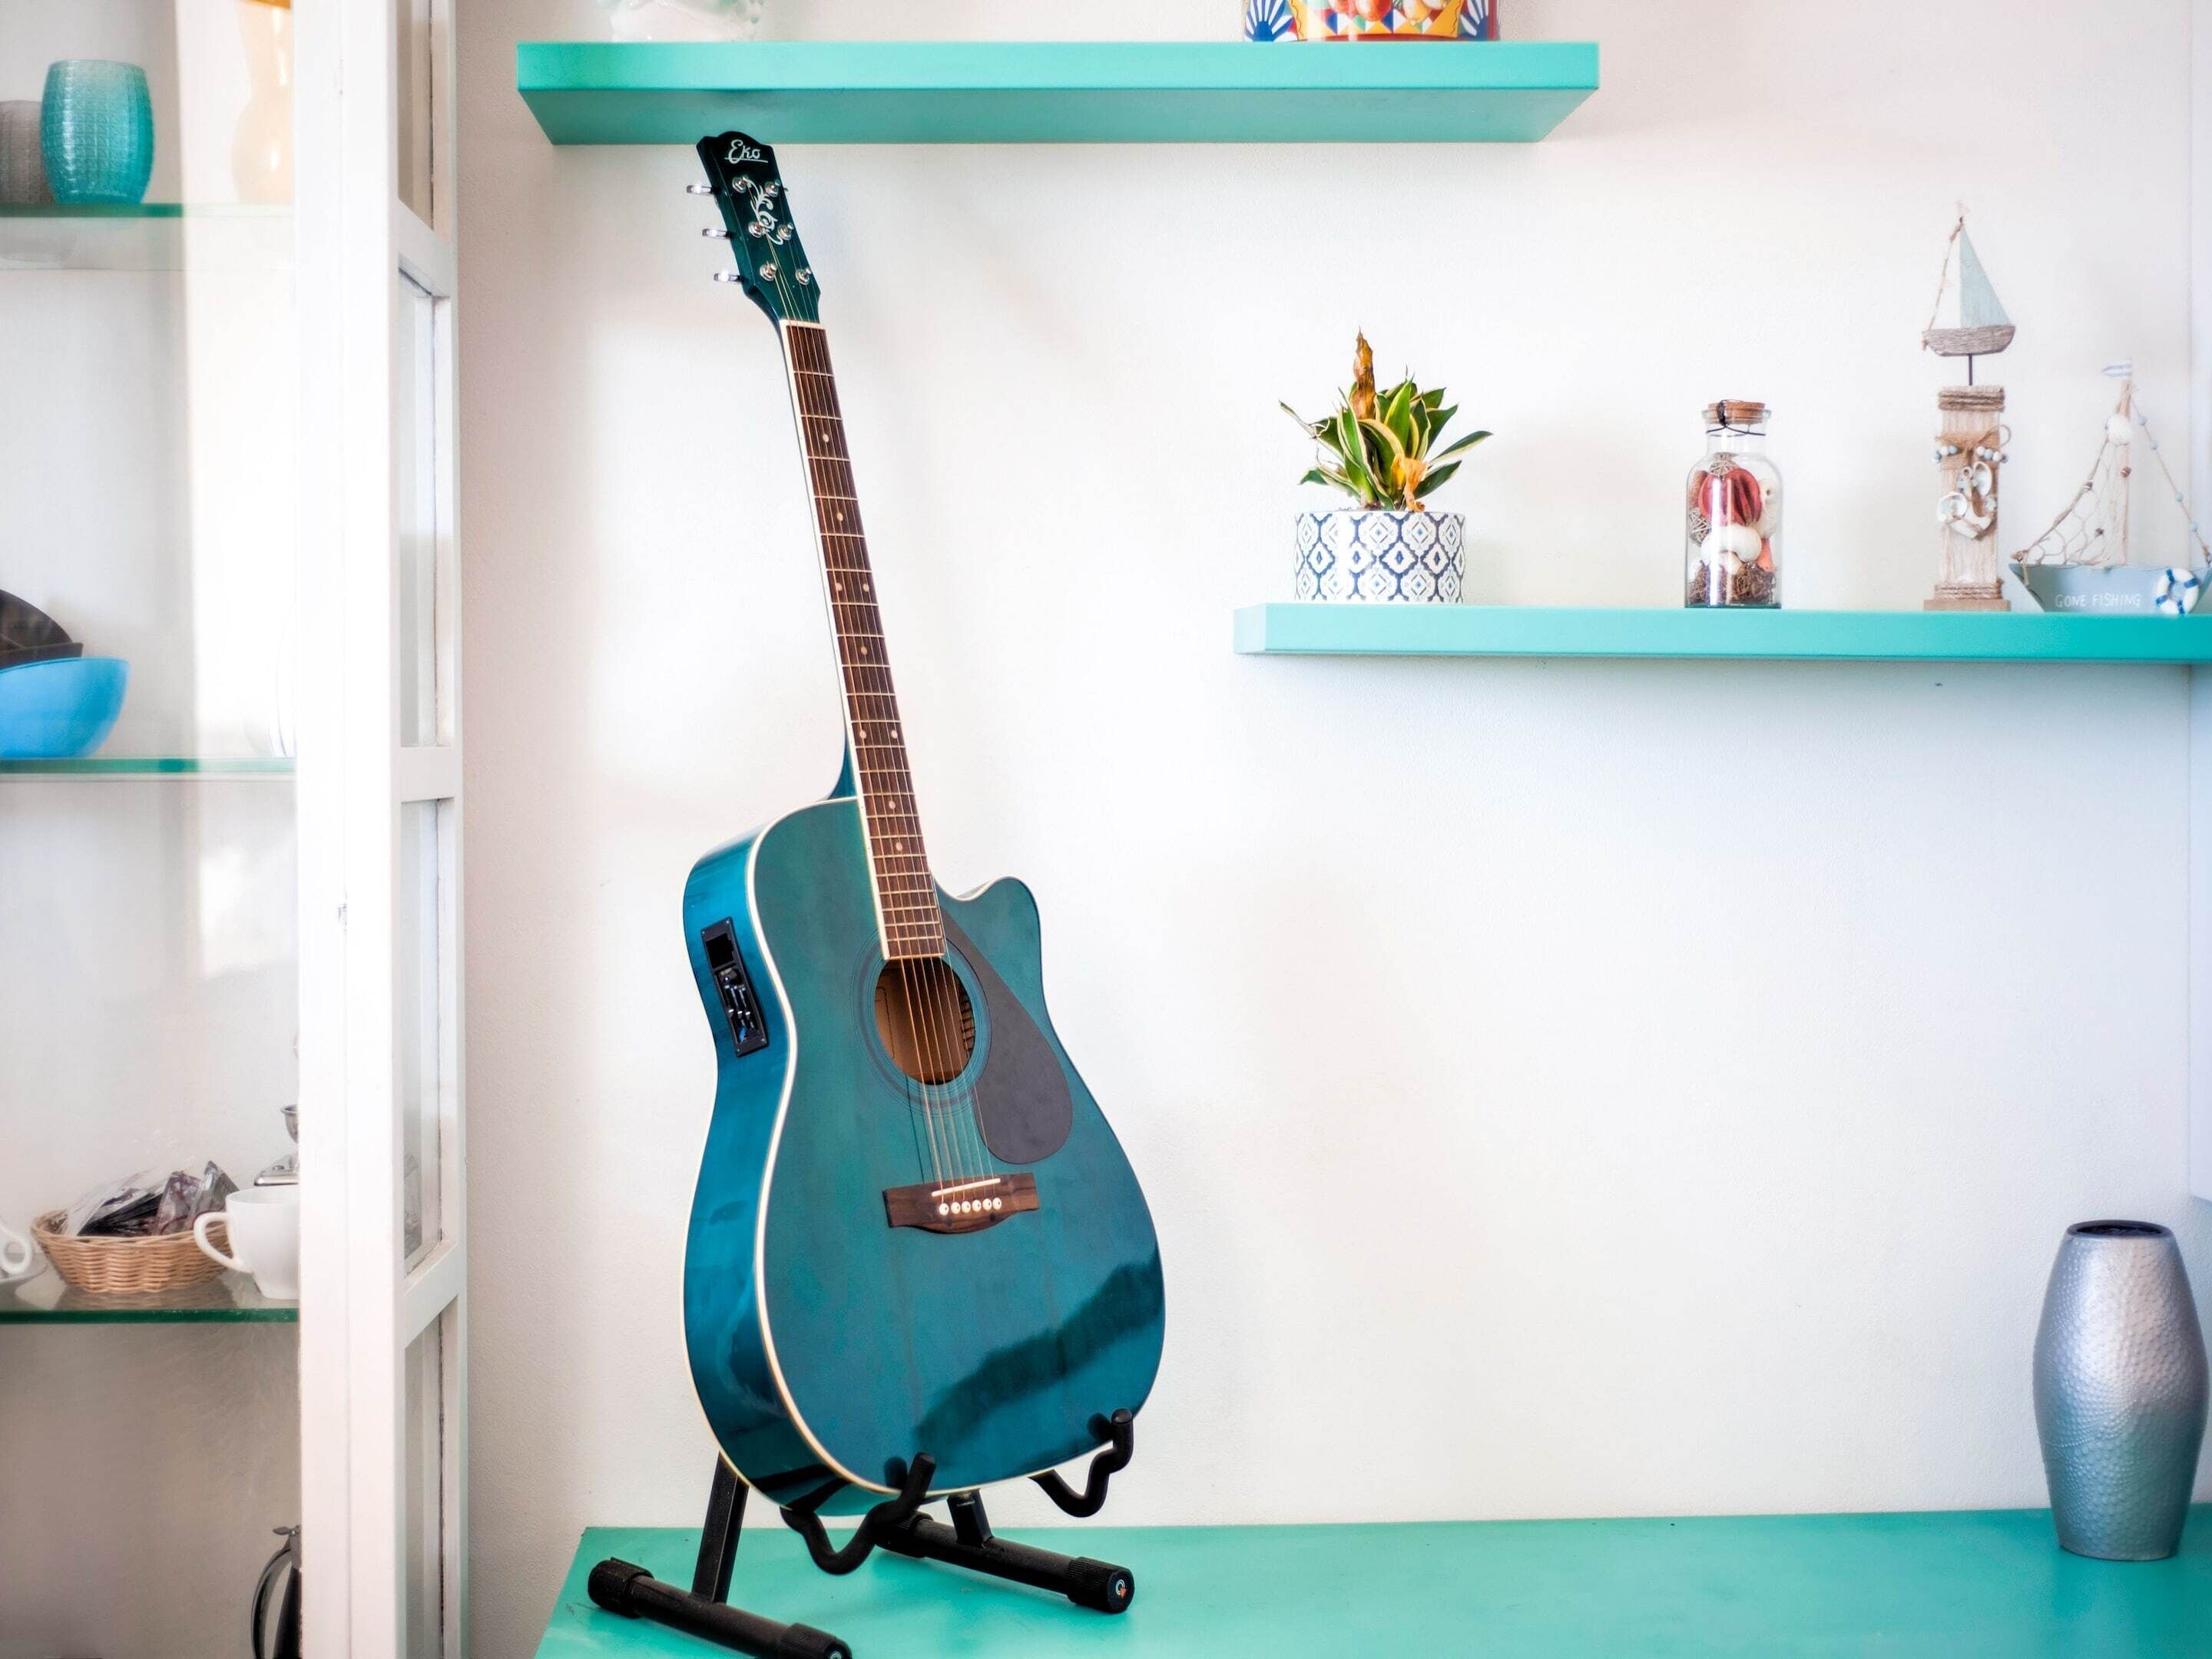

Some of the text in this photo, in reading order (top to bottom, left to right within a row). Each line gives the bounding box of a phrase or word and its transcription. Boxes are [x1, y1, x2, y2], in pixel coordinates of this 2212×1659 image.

[729, 139, 760, 164] Eko
[2055, 592, 2141, 608] GONE FISHING
